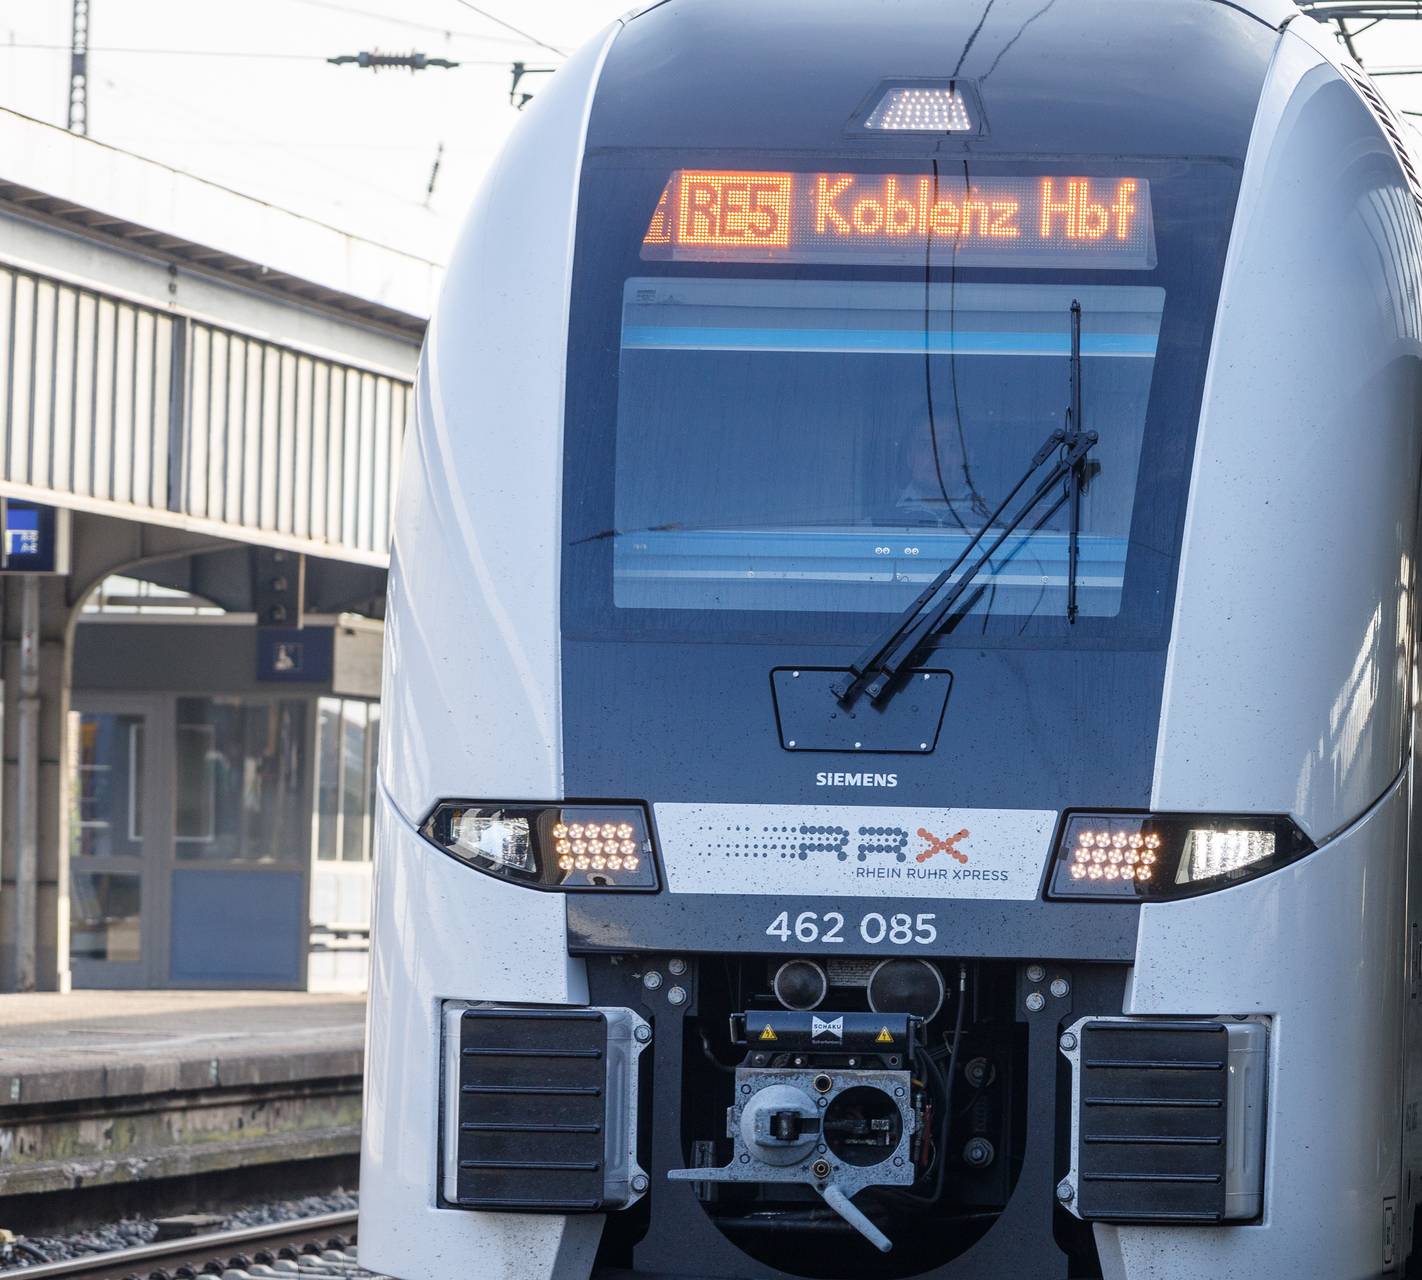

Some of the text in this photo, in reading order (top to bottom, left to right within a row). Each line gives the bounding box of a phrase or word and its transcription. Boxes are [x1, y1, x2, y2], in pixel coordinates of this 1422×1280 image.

[685, 180, 783, 240] RE5
[814, 175, 1020, 238] Koblenz
[1041, 177, 1137, 240] Hbf
[815, 771, 899, 788] SIEMENS
[798, 825, 970, 864] RRX
[856, 867, 1009, 881] RHEIN RUHR XPRESS
[766, 911, 937, 945] 462 085
